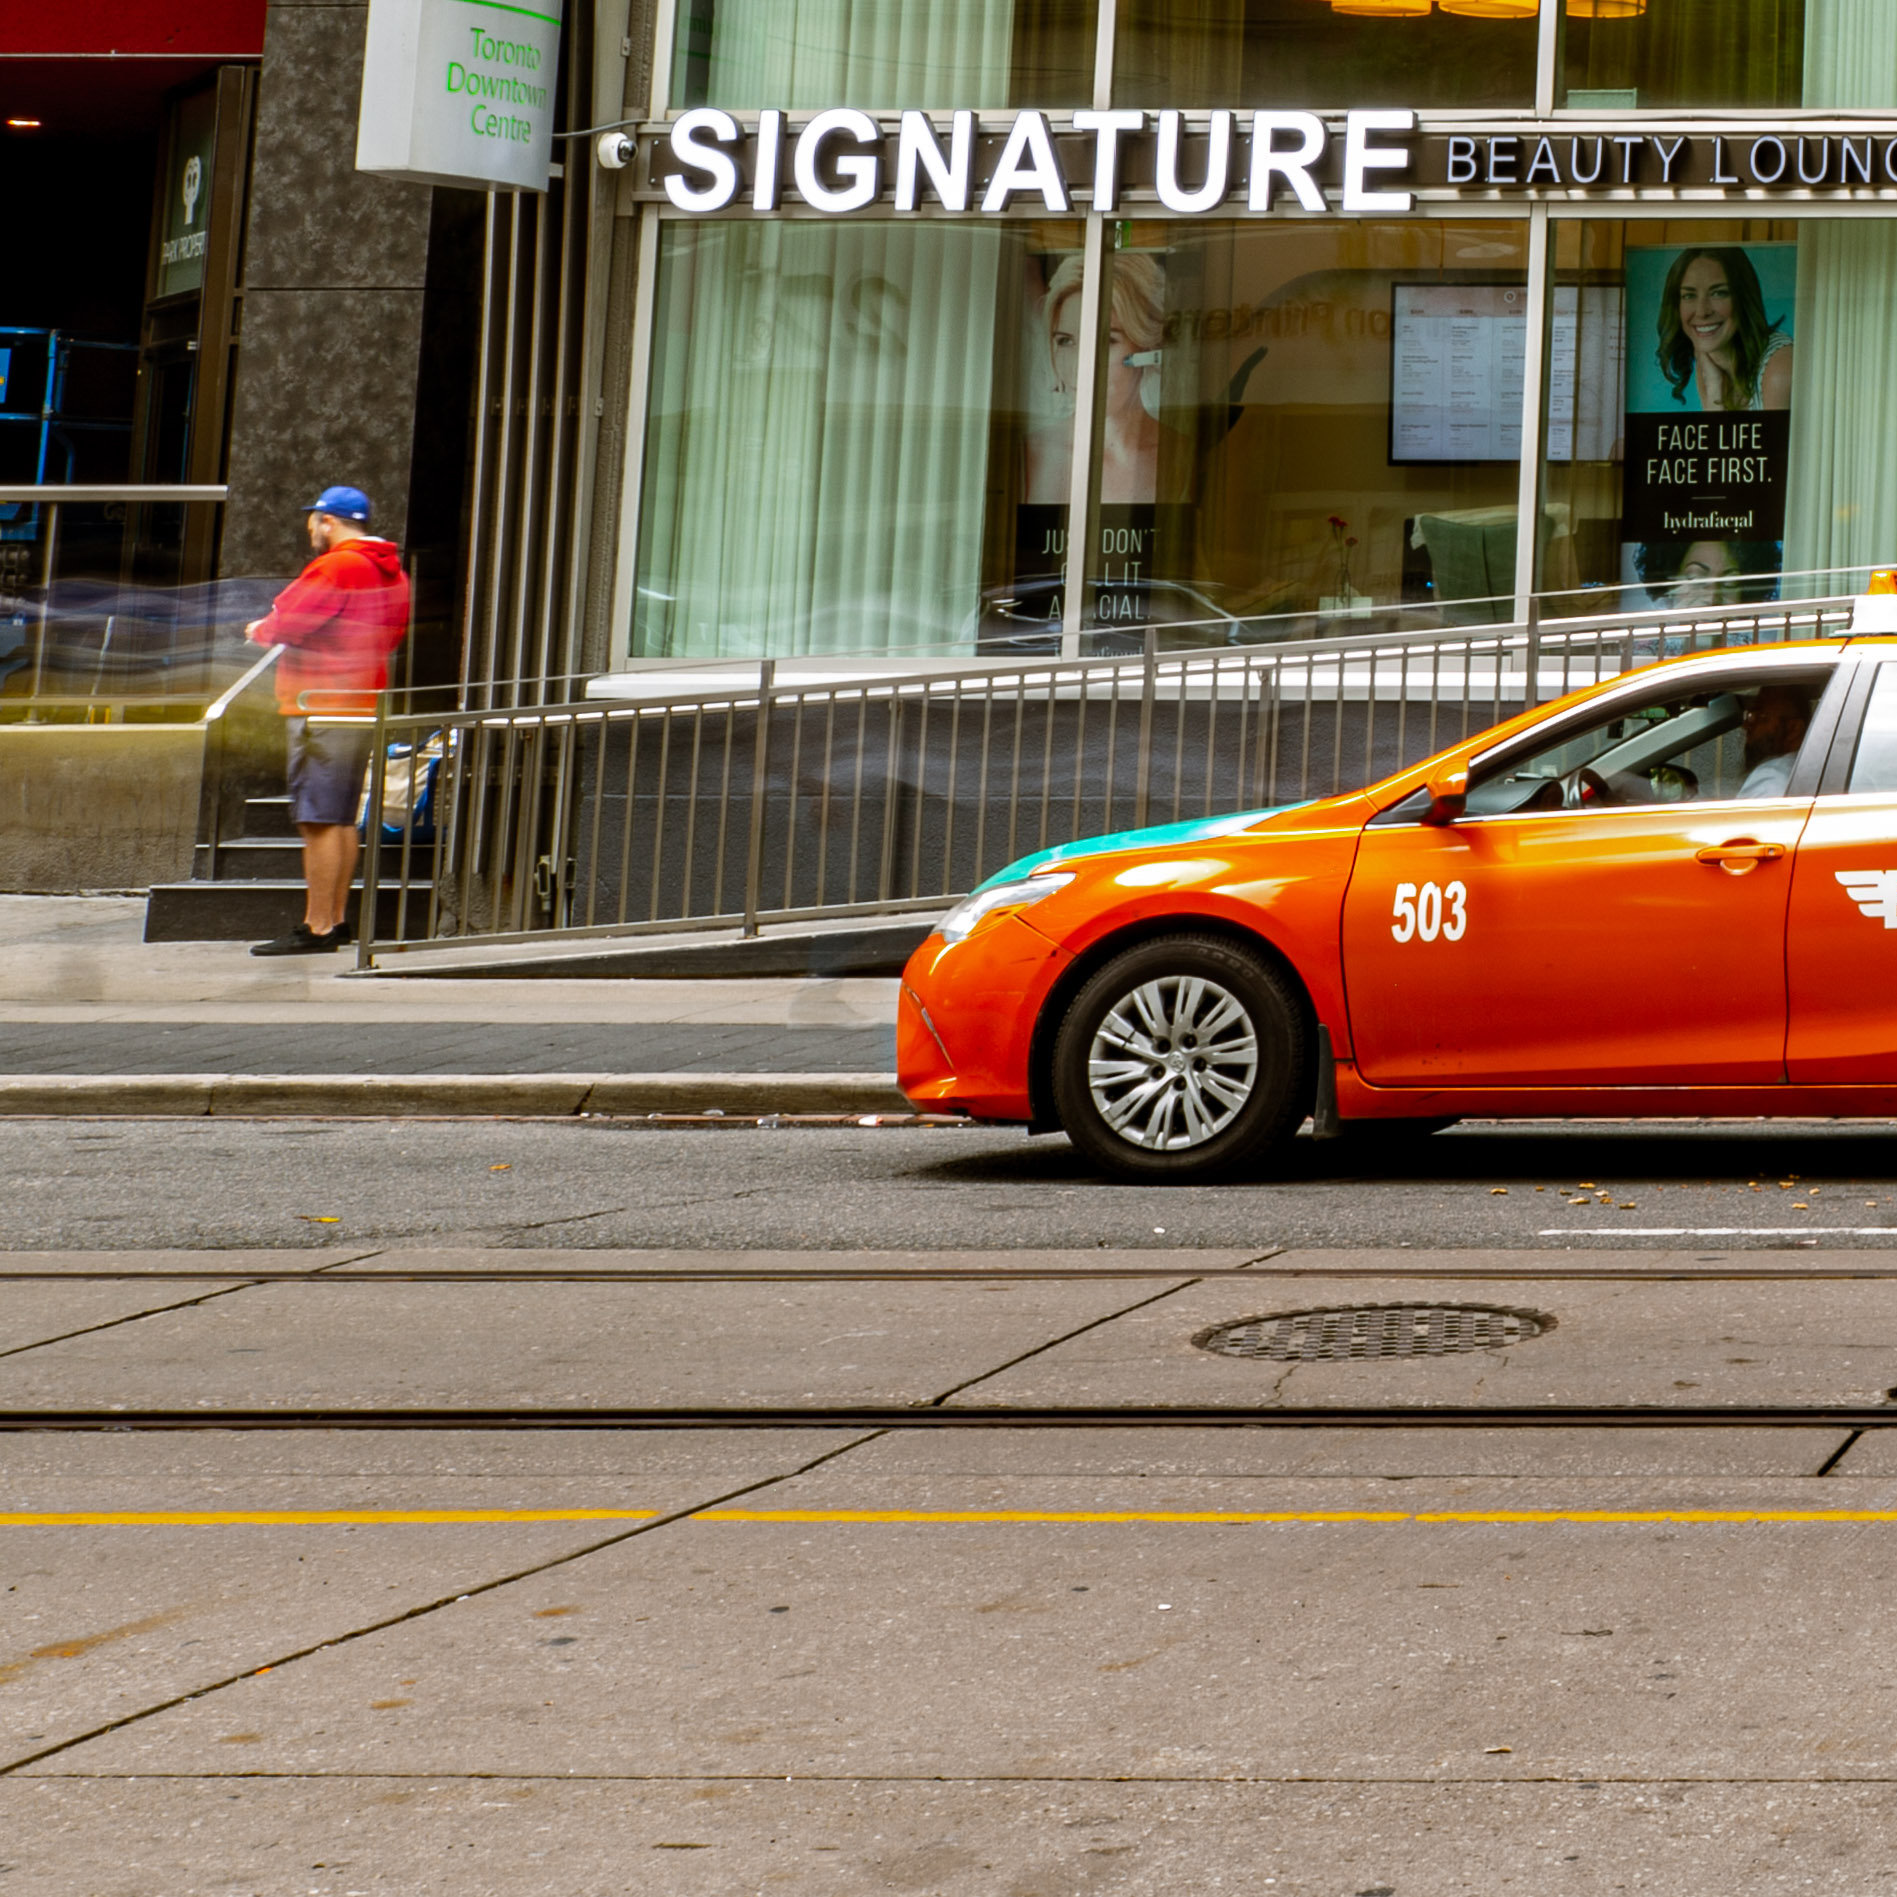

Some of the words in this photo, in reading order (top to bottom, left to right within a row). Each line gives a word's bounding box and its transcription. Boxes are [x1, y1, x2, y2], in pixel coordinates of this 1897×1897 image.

[470, 26, 542, 71] Toronto
[446, 61, 548, 112] Downtown
[470, 104, 532, 144] Centre
[664, 107, 1419, 214] SIGNATURE
[1446, 135, 1686, 185] BEAUTY
[1657, 424, 1710, 451] FACE
[1718, 423, 1763, 450] LIFE
[1646, 458, 1699, 485] FACE
[1707, 456, 1773, 484] FIRST.
[1663, 509, 1754, 535] hydrafacial
[1123, 561, 1143, 587] IT
[1048, 594, 1062, 620] A
[1391, 879, 1469, 943] 503
